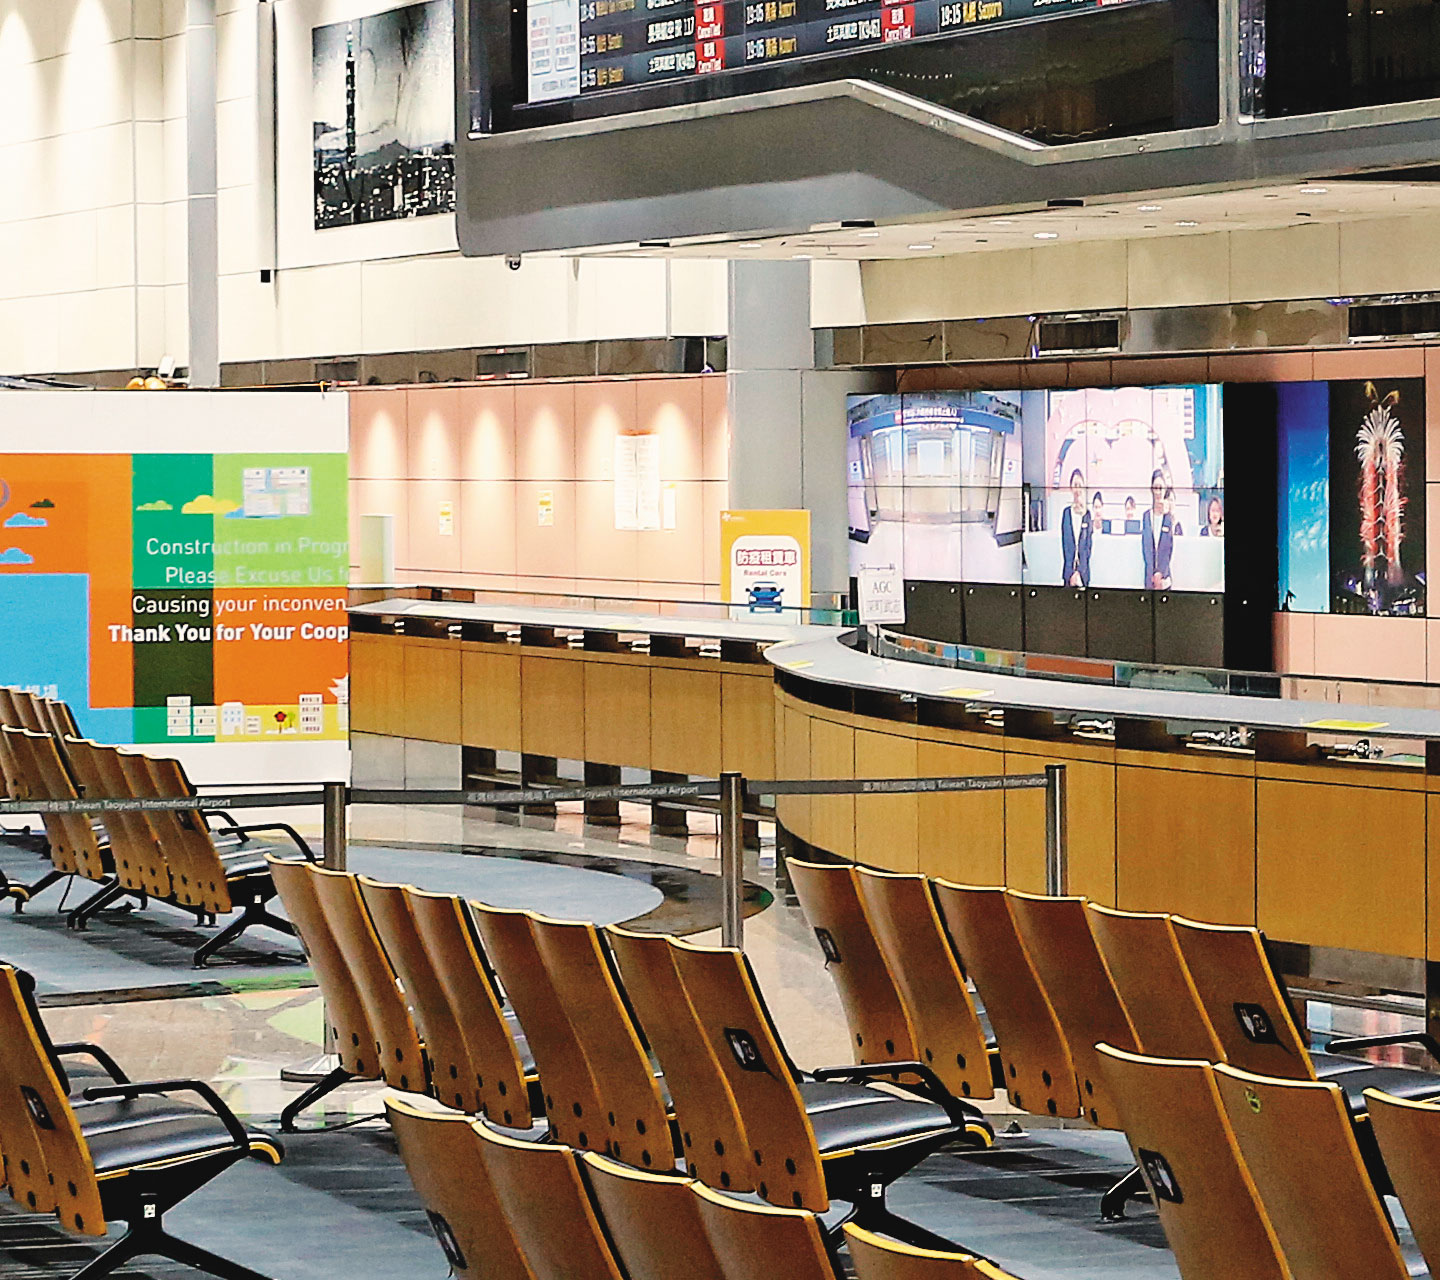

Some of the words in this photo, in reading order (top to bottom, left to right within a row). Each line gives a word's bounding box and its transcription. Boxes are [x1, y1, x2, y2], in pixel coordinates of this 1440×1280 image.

[146, 537, 268, 555] Construction
[275, 539, 291, 553] in
[165, 566, 229, 584] Please
[235, 566, 302, 583] Excuse
[309, 567, 333, 583] Us
[132, 595, 209, 617] Causing
[215, 598, 257, 617] your
[108, 624, 170, 642] Thank
[175, 624, 211, 641] You
[216, 624, 245, 640] for
[250, 623, 295, 640] Your
